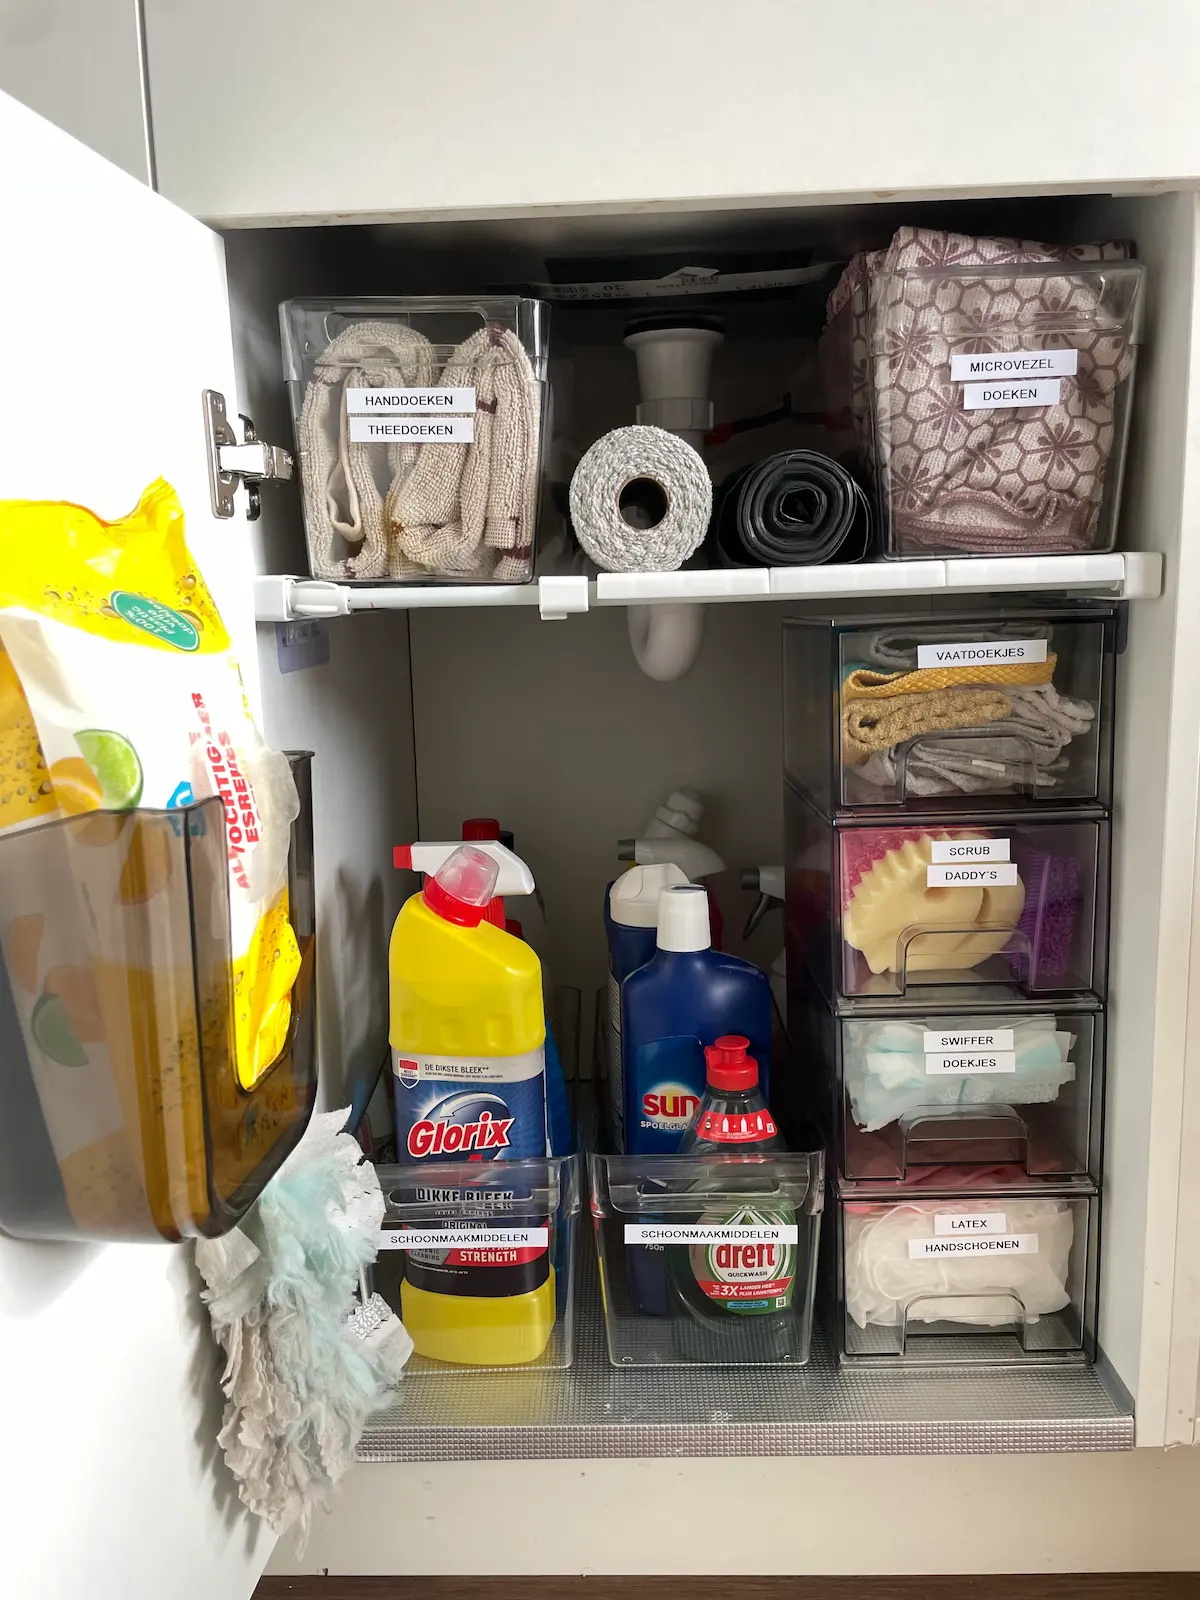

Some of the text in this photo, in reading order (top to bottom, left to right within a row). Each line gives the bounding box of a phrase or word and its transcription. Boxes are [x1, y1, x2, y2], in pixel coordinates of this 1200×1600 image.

[969, 358, 1055, 373] MICROVEZEL
[365, 395, 453, 406] HANDDOEKEN
[983, 388, 1038, 401] DOEKEN
[368, 425, 453, 435] THEEDOEKEN
[147, 609, 175, 628] vrije
[936, 647, 1025, 661] VAATDOEKJES
[949, 846, 991, 856] SCRUB
[941, 1036, 994, 1045] SWIFFER
[435, 1064, 459, 1073] DIKSTE
[943, 1059, 996, 1068] DOEKJES
[641, 1092, 701, 1118] sun
[640, 1120, 688, 1131] SPOELGLA
[407, 1111, 515, 1158] Glorix
[951, 1219, 988, 1229] LATEX
[390, 1233, 529, 1244] SCHOONMAAKMIDDELEN
[640, 1230, 779, 1239] SCHOONMAAKMIDDELEN
[925, 1240, 1020, 1253] HANDSCHOENEN
[411, 1249, 440, 1261] CLEANING
[460, 1250, 518, 1263] STRENGTH
[716, 1244, 775, 1269] dreft
[720, 1285, 739, 1297] 3X
